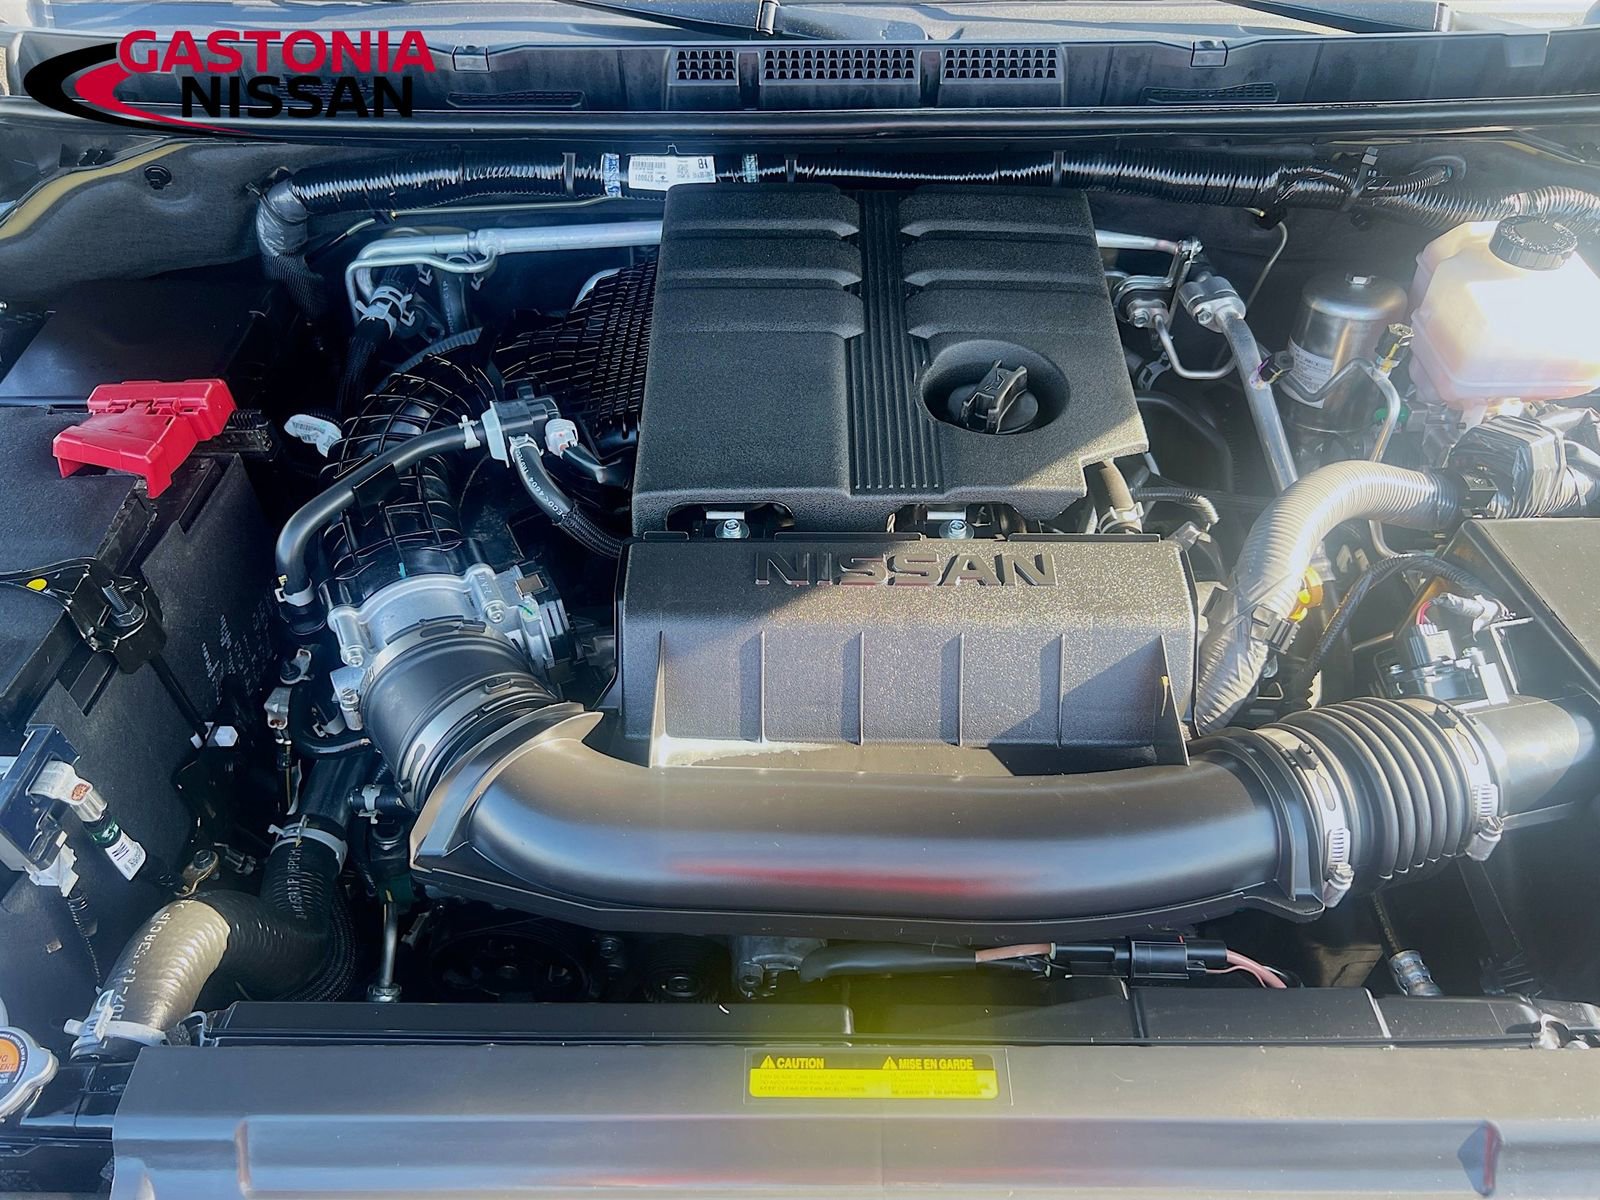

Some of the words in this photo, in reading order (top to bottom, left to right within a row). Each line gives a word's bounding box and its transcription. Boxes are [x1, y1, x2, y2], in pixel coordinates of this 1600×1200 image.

[755, 552, 1056, 585] NISSAN
[777, 1058, 824, 1070] CAUTION
[899, 1059, 923, 1071] MISE
[925, 1059, 938, 1071] EN
[939, 1059, 975, 1071] GARDE
